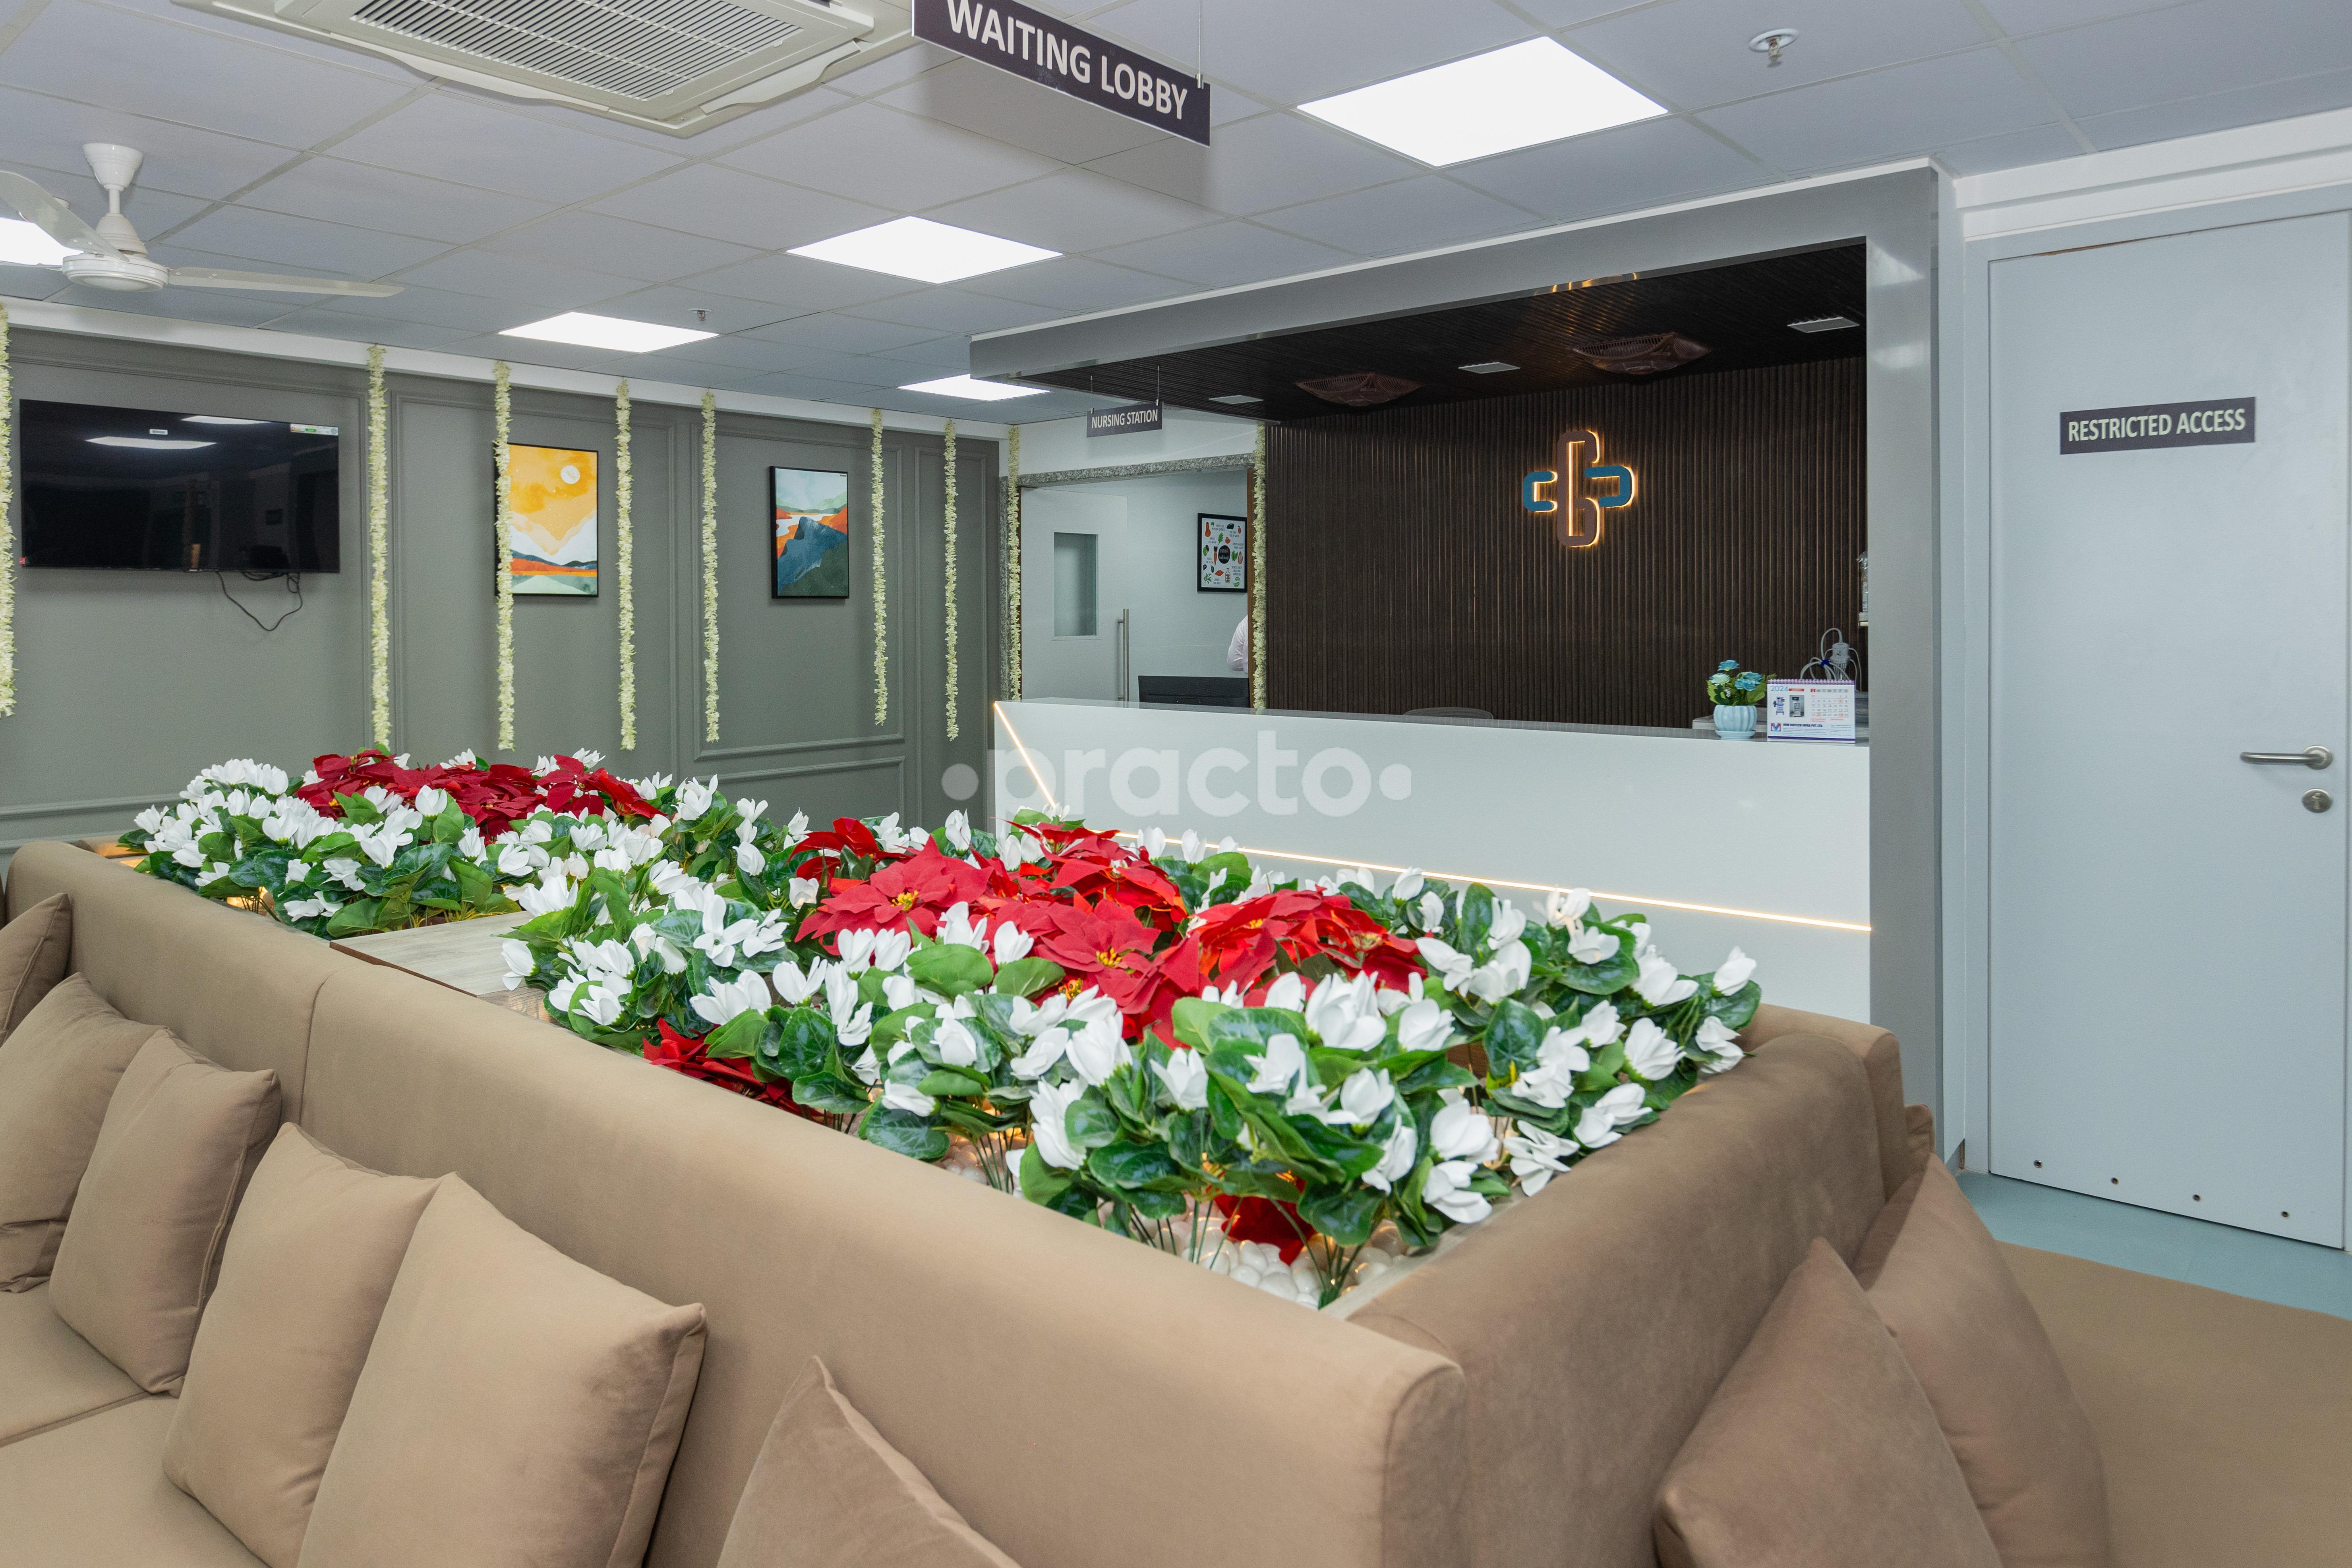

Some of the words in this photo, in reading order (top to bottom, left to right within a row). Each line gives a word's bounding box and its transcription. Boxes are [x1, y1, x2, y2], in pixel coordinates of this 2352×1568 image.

[947, 0, 1091, 83] WAITING
[1101, 55, 1188, 120] LOBBY
[1092, 413, 1125, 429] NURSING
[1127, 409, 1158, 425] STATION
[2068, 414, 2172, 441] RESTRICTED
[2176, 408, 2246, 434] ACCESS
